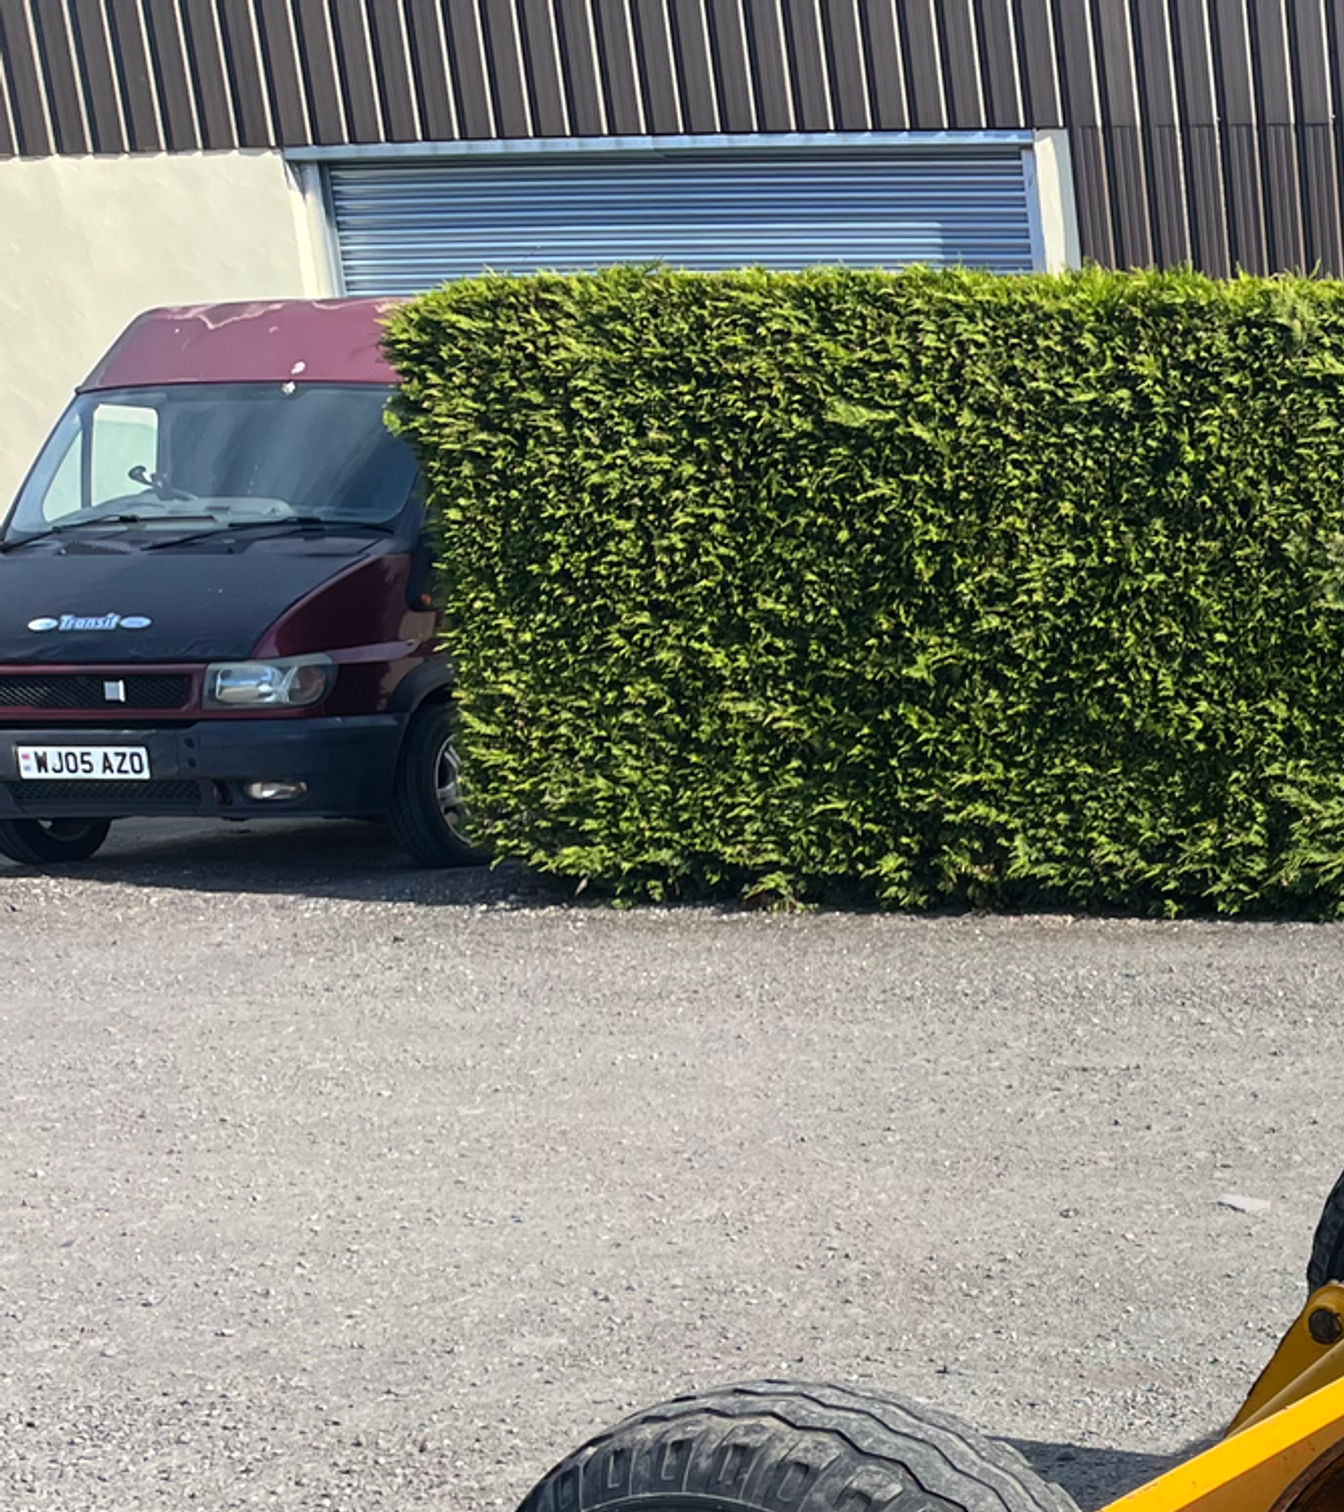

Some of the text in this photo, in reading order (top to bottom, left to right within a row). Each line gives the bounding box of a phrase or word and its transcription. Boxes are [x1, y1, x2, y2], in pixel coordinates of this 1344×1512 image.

[59, 612, 121, 630] Transit
[33, 751, 94, 774] WJ05
[102, 751, 144, 774] AZO
